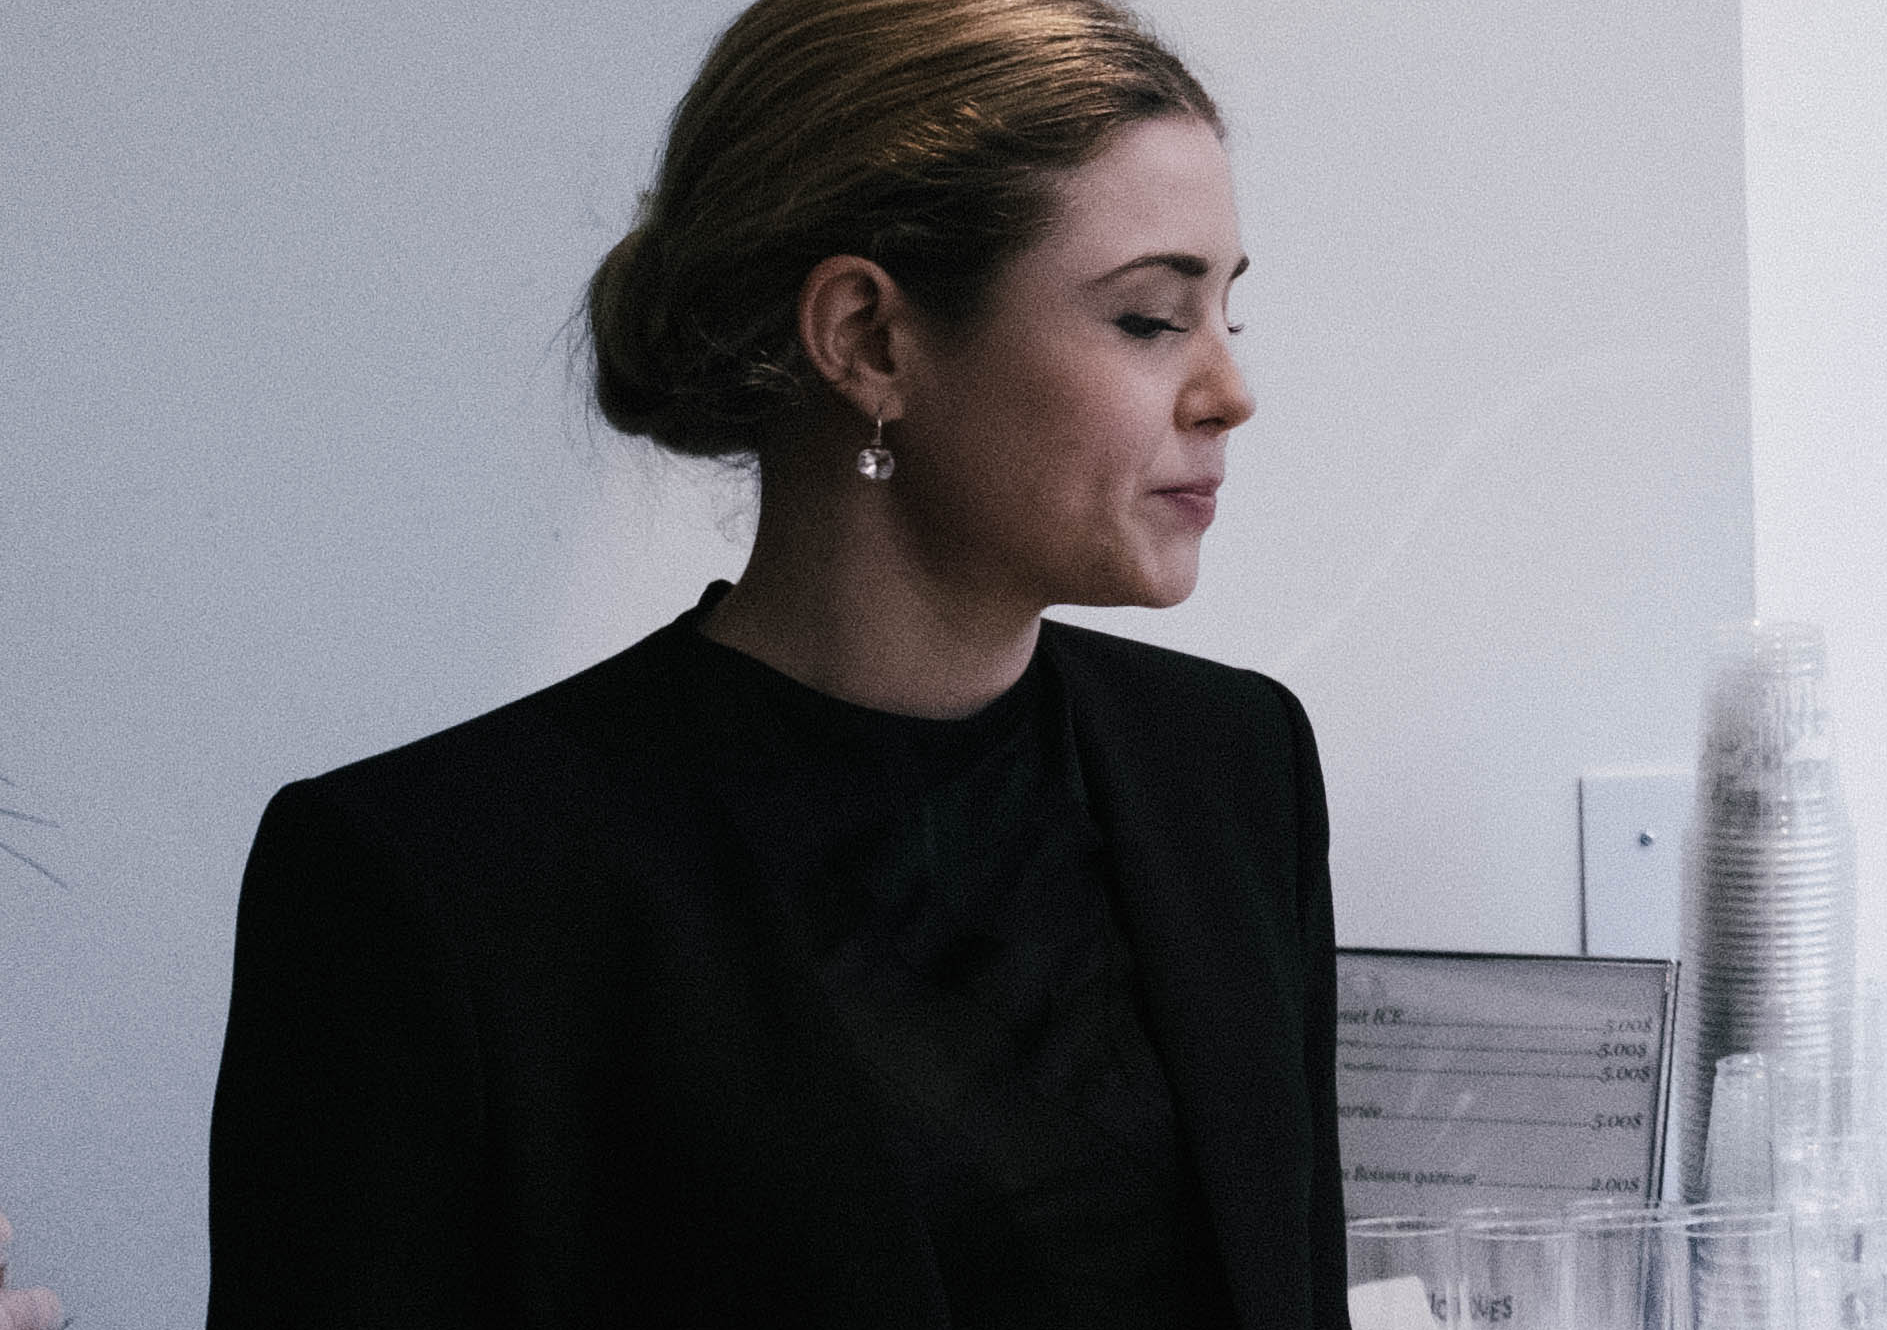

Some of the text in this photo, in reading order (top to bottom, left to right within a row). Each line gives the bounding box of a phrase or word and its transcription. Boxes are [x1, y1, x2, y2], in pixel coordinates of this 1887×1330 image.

[1594, 1041, 1647, 1059] 5.00$
[1596, 1065, 1650, 1083] 5.00$
[1589, 1112, 1643, 1131] 5.00$
